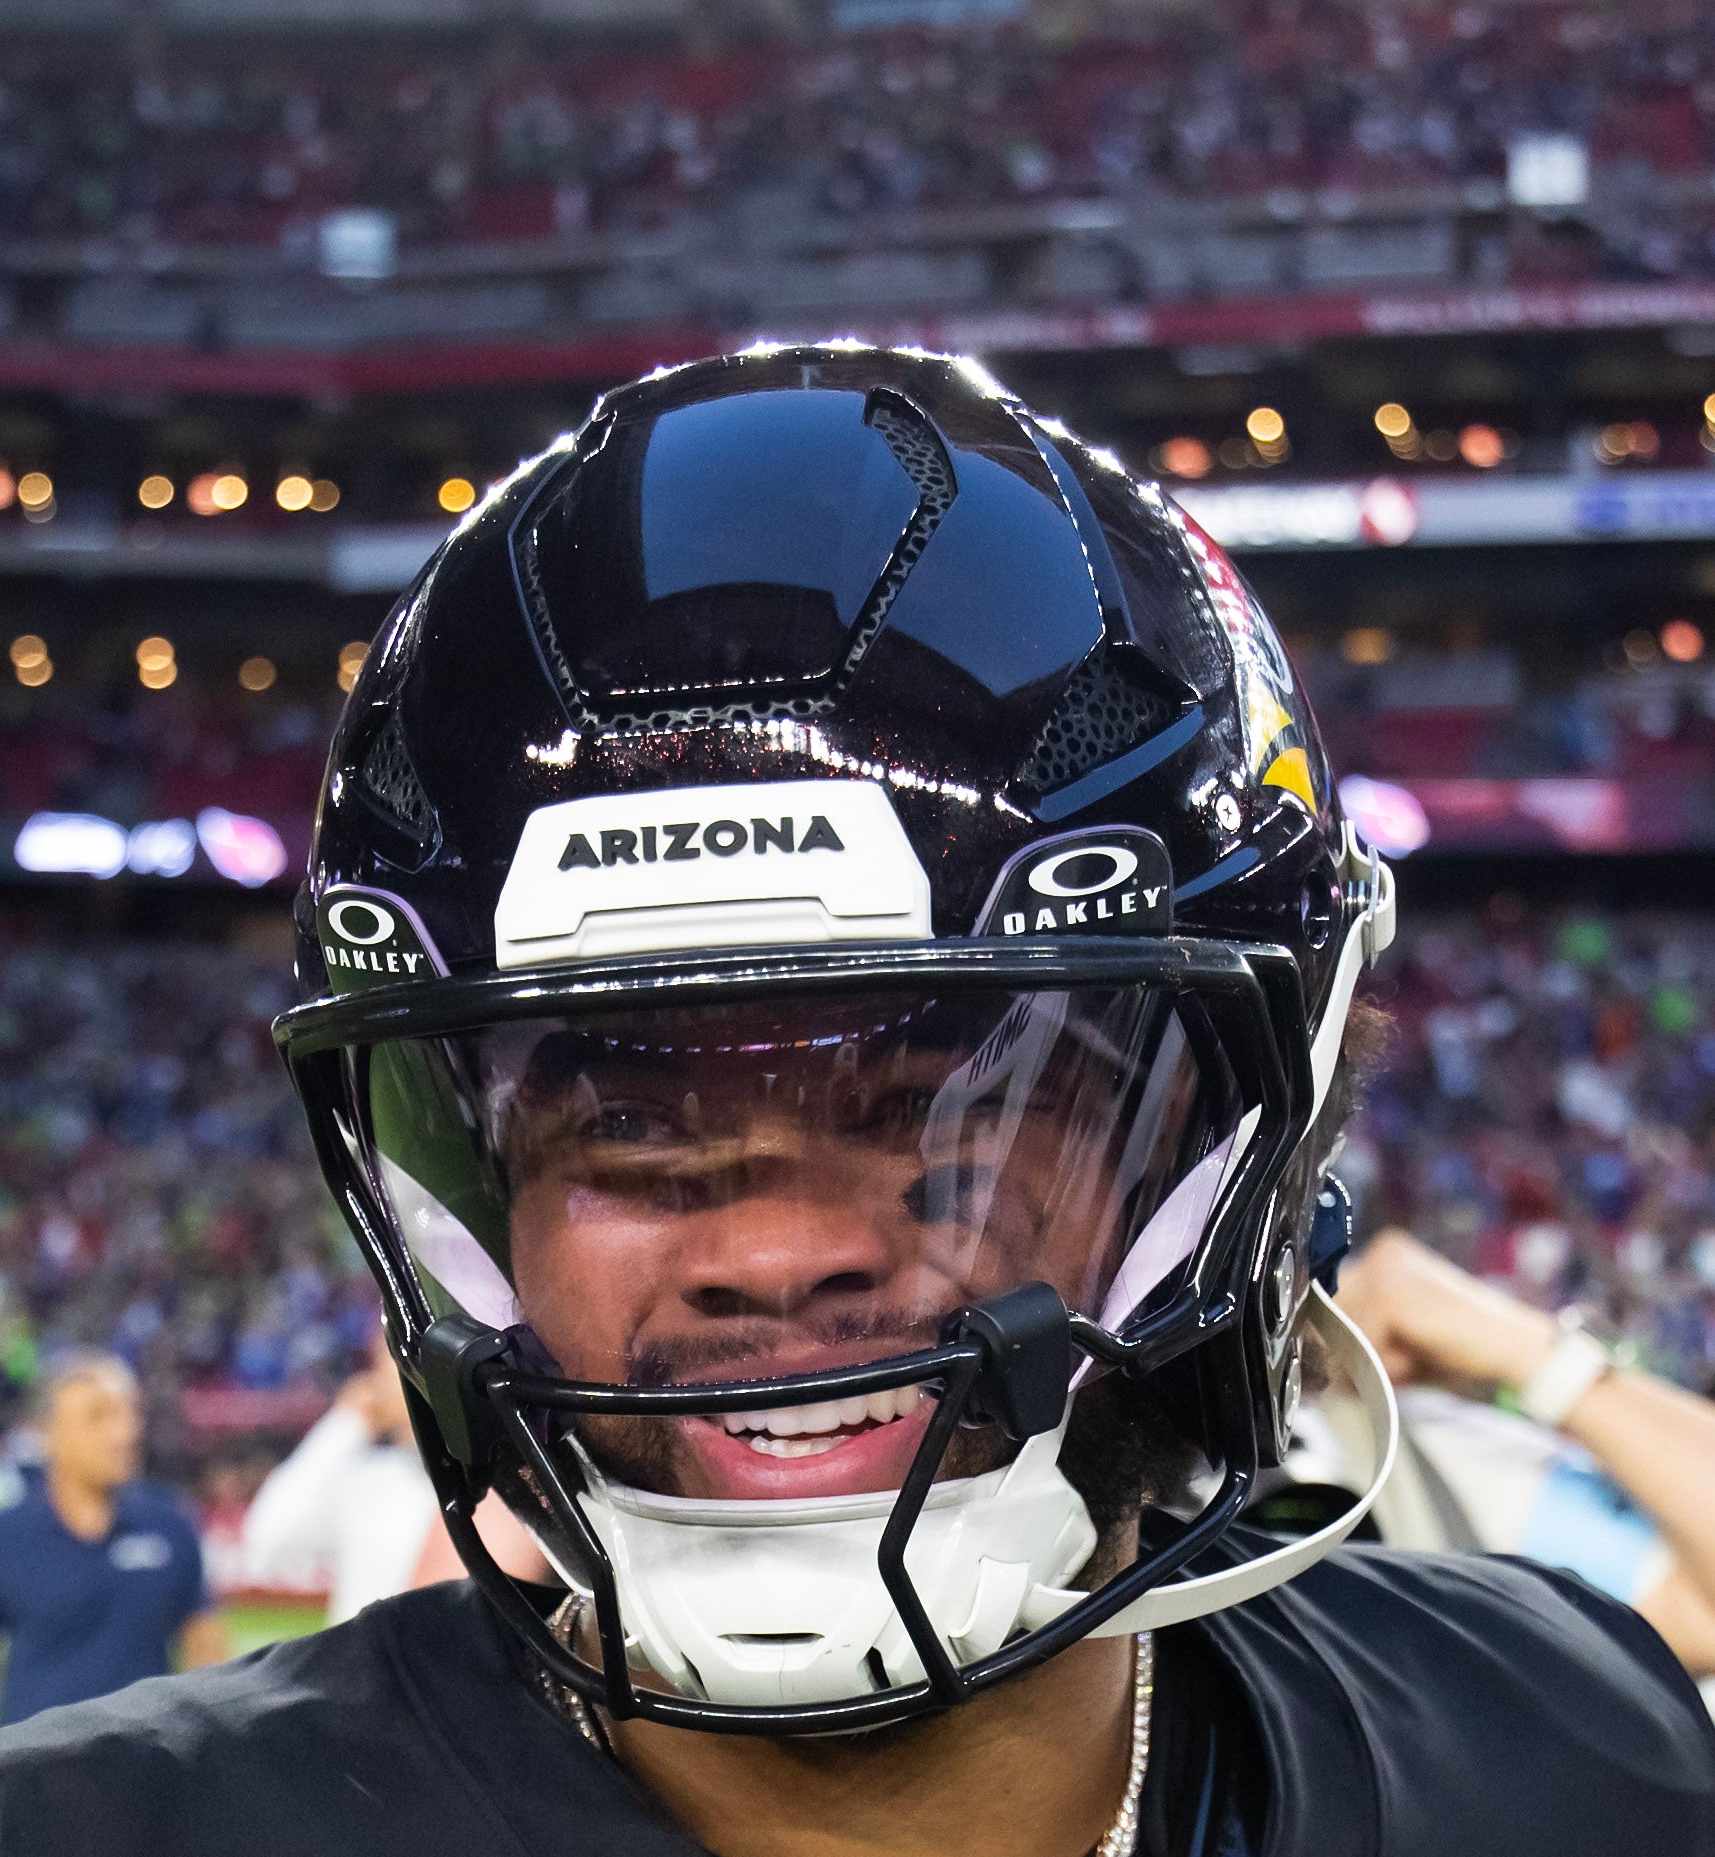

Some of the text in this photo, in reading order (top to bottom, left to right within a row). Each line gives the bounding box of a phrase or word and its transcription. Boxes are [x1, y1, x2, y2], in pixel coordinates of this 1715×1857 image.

[557, 815, 846, 872] ARIZONA
[1003, 886, 1161, 935] OAKLEY
[324, 945, 418, 973] OAKLEY
